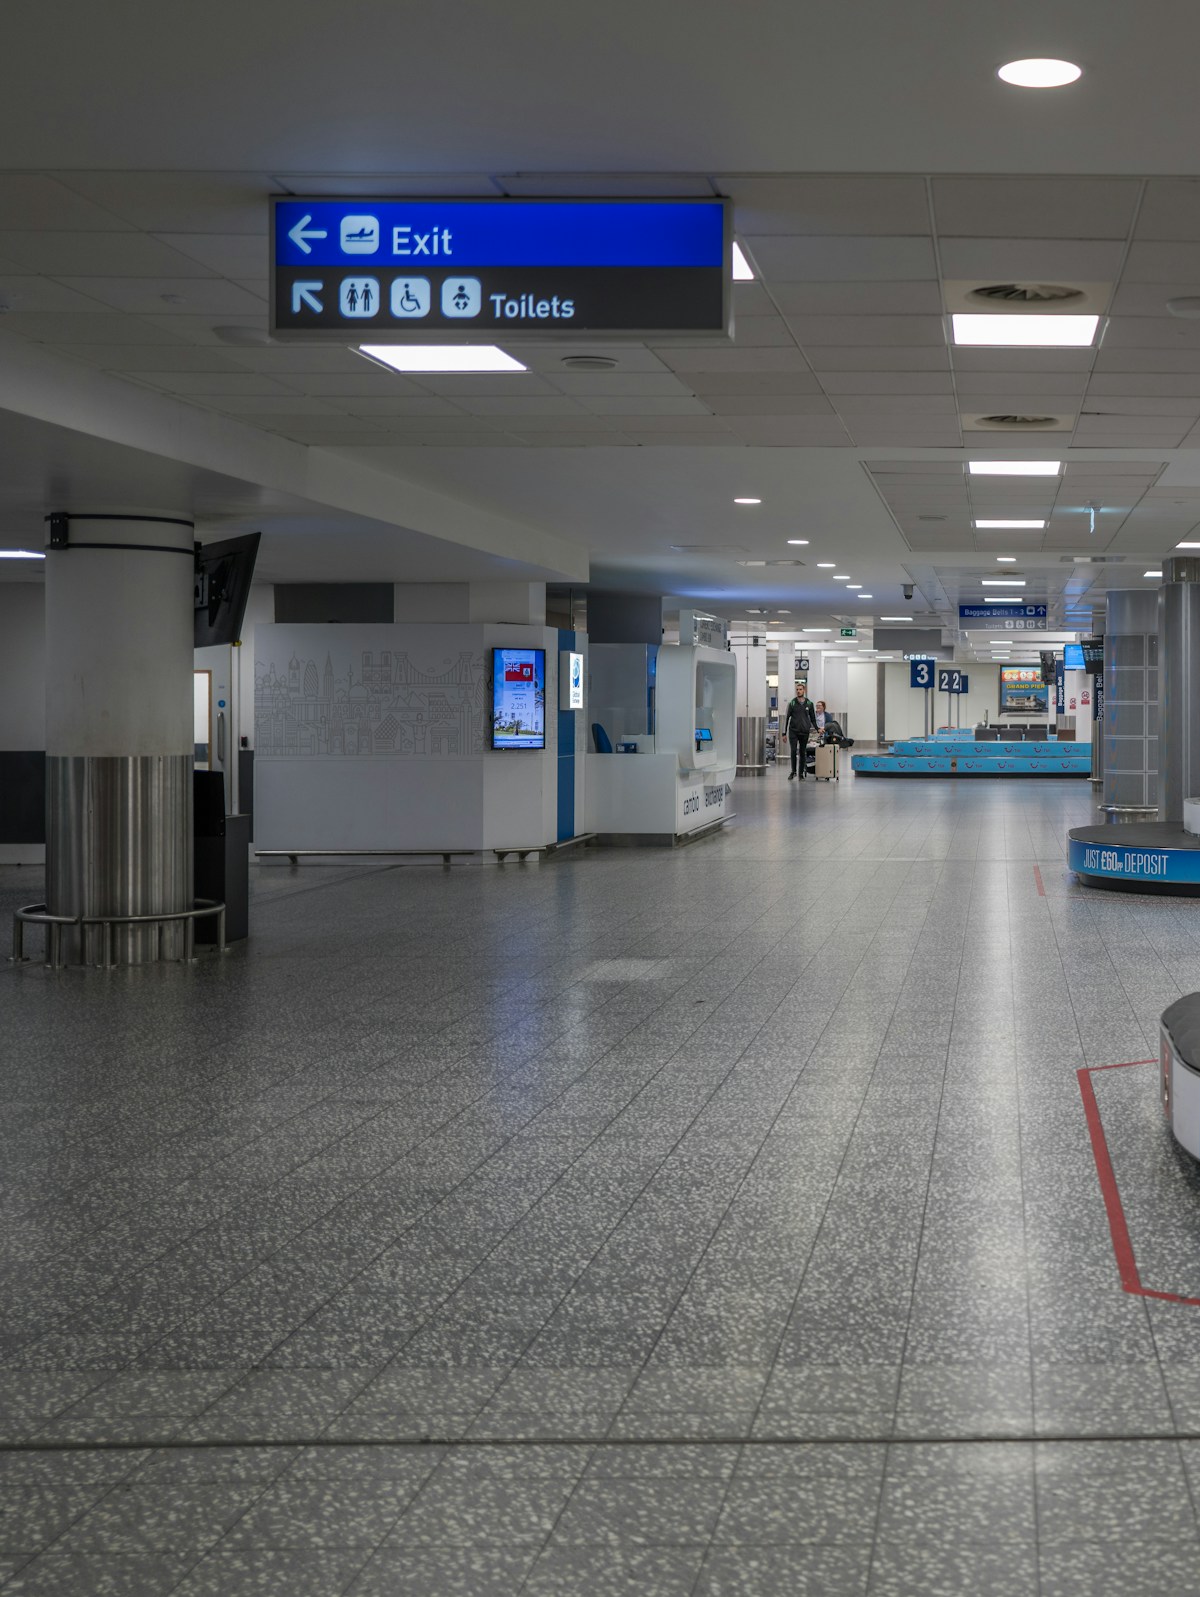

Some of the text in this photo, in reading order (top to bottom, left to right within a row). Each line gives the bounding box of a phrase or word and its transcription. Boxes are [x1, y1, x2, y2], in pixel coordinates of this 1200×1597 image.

[391, 226, 453, 255] Exit
[490, 293, 576, 319] Toilets
[916, 663, 929, 684] 3
[941, 672, 949, 689] 2
[952, 672, 960, 689] 2
[1083, 849, 1100, 869] JUST
[1124, 853, 1169, 876] DEPOSIT
